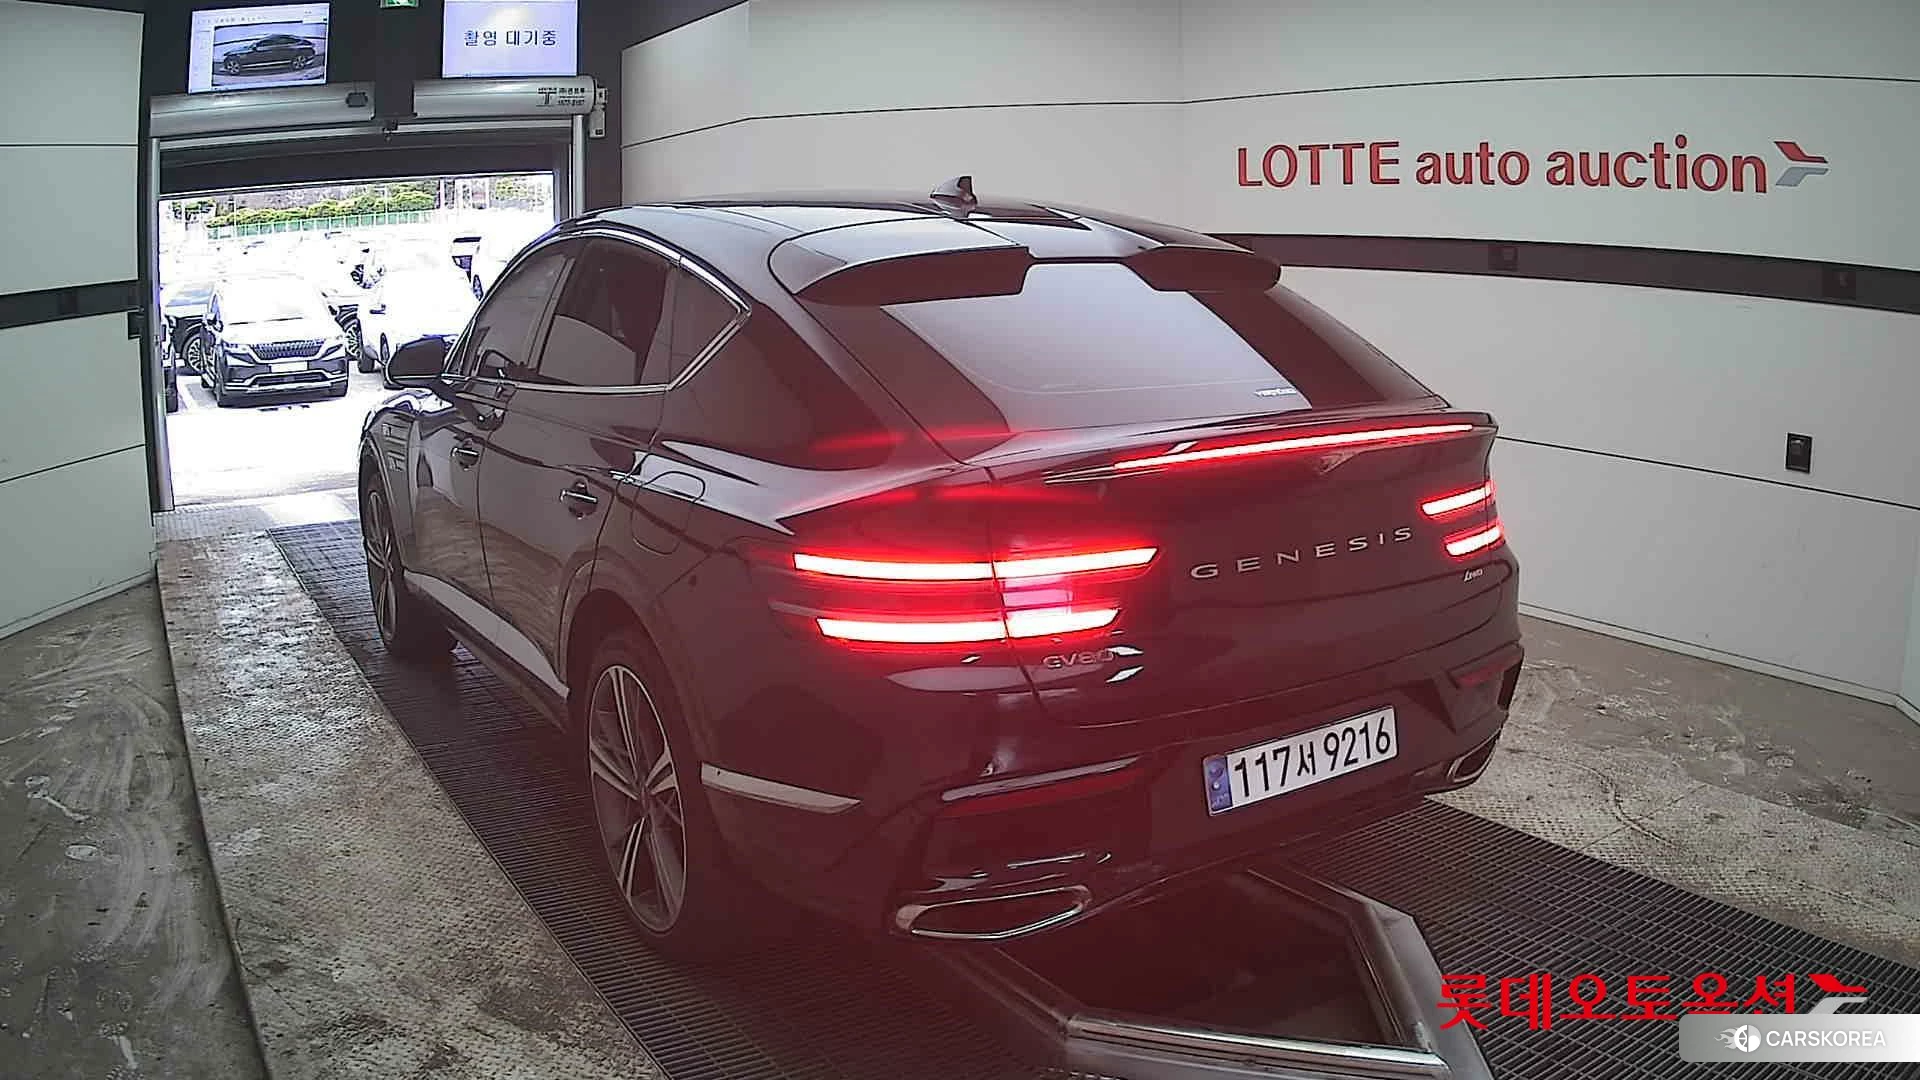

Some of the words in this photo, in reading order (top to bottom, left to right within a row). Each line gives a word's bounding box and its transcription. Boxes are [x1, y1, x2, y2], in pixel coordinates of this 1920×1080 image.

[463, 30, 497, 47] 촬영
[505, 30, 556, 46] 대기중
[1238, 141, 1400, 187] LOTTE
[1415, 142, 1530, 187] auto
[1545, 134, 1768, 193] auction
[1190, 526, 1413, 580] GENESIS
[1042, 647, 1114, 668] GV80
